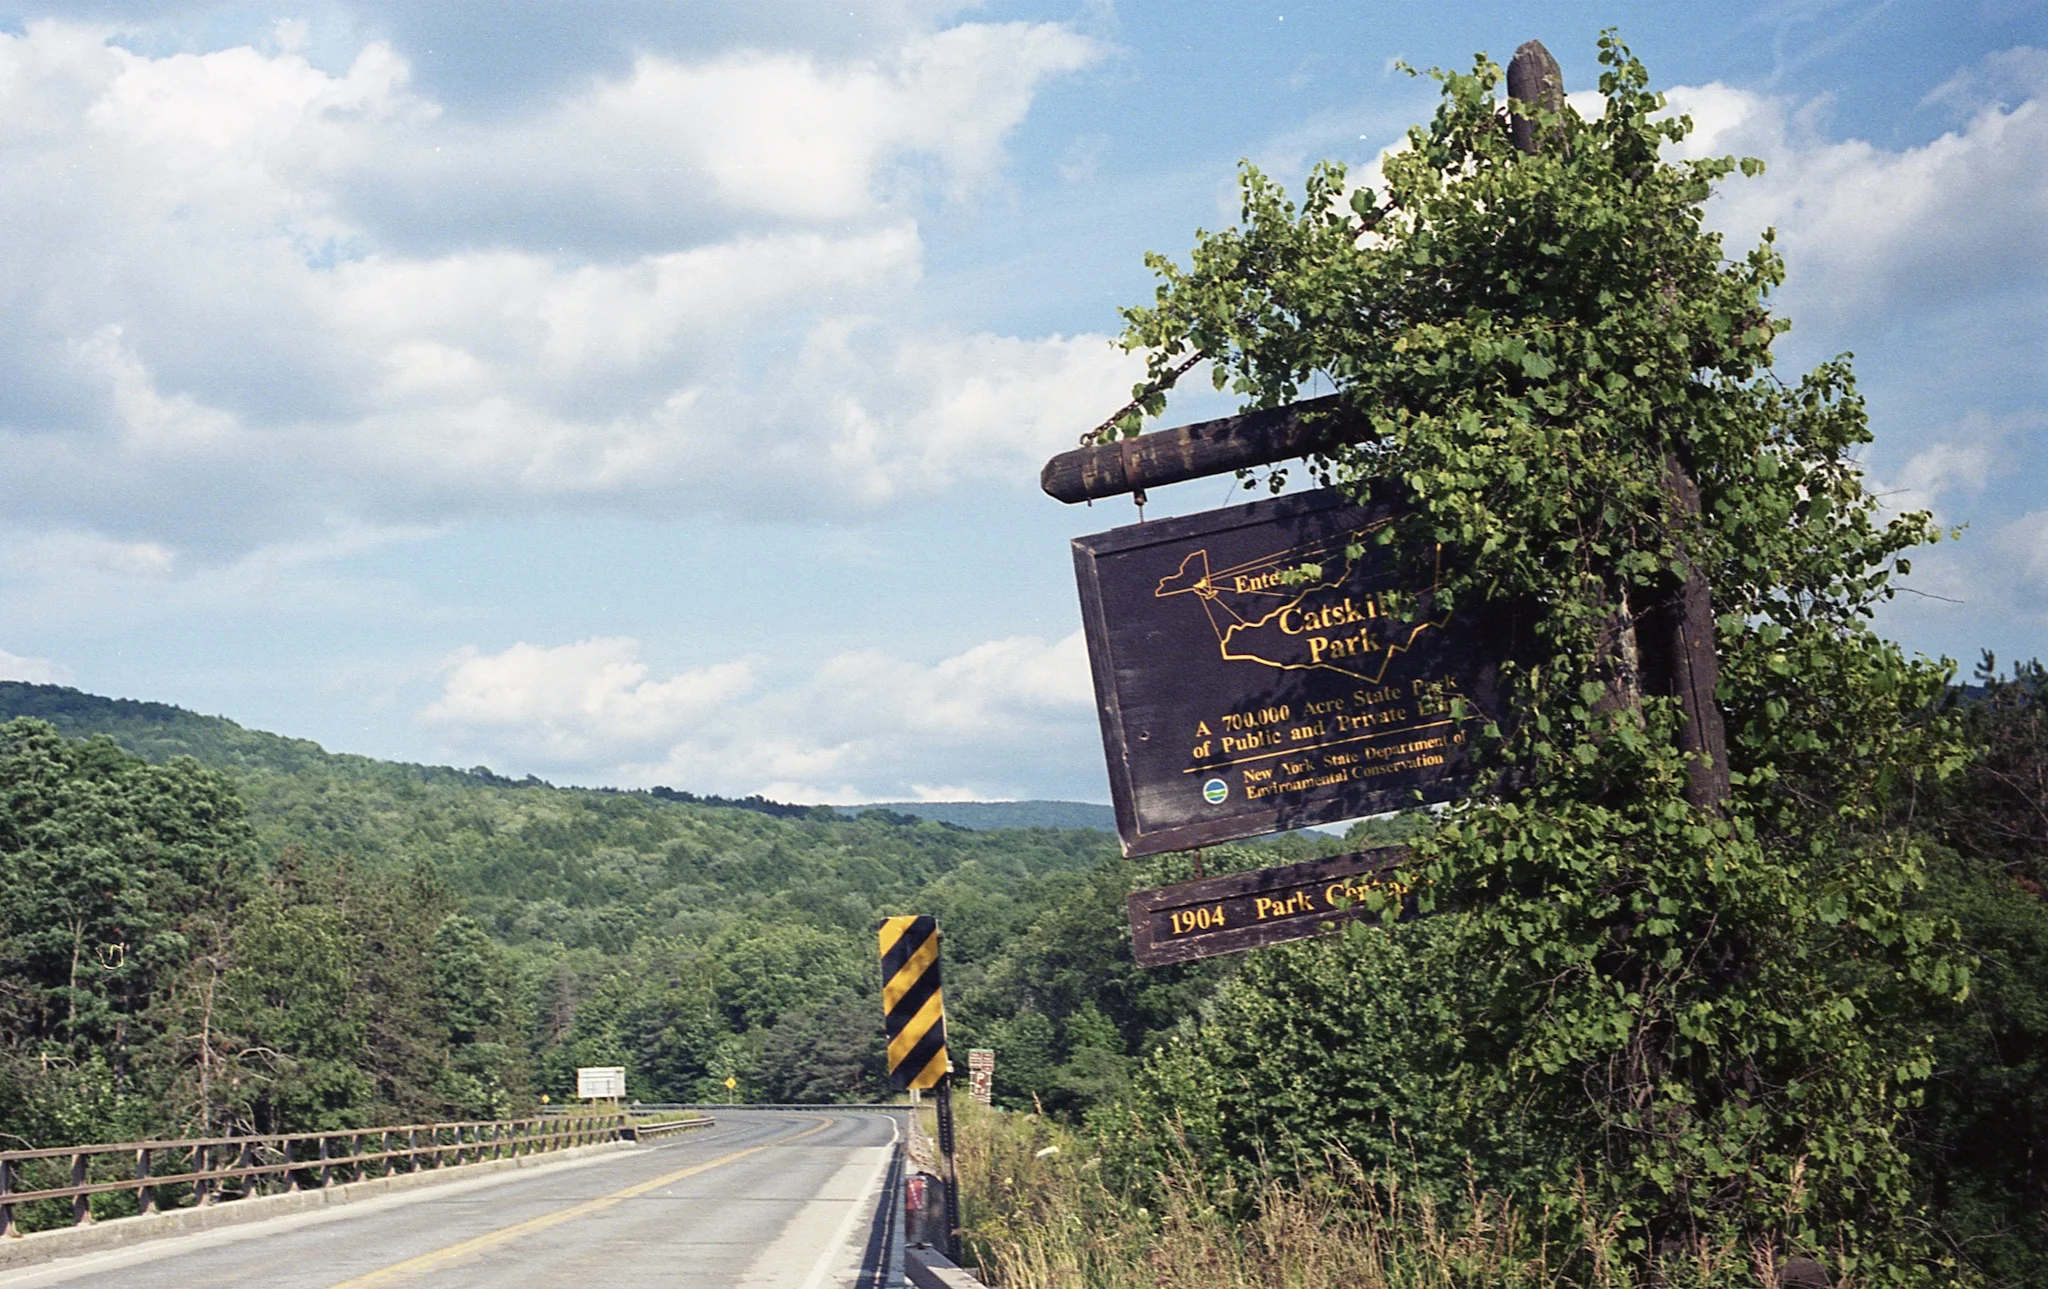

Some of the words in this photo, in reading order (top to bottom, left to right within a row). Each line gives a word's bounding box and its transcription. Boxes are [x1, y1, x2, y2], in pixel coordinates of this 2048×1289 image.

[1234, 564, 1321, 594] Ente
[1279, 590, 1398, 635] Catskil
[1307, 627, 1381, 663] Park
[1195, 720, 1212, 737] A
[1303, 698, 1345, 716] Acre
[1352, 686, 1402, 708] State
[1412, 673, 1459, 696] Pak
[1192, 740, 1212, 759] of
[1221, 730, 1282, 753] Public
[1290, 720, 1326, 740] and
[1336, 708, 1407, 732] Private
[1242, 768, 1273, 784] New
[1281, 758, 1316, 775] York
[1322, 753, 1360, 768] State
[1364, 734, 1448, 761] Department
[1453, 729, 1467, 744] of
[1245, 768, 1349, 800] Environmental
[1351, 753, 1444, 779] Conservation
[1169, 905, 1226, 935] 1904
[1255, 890, 1316, 920] Park
